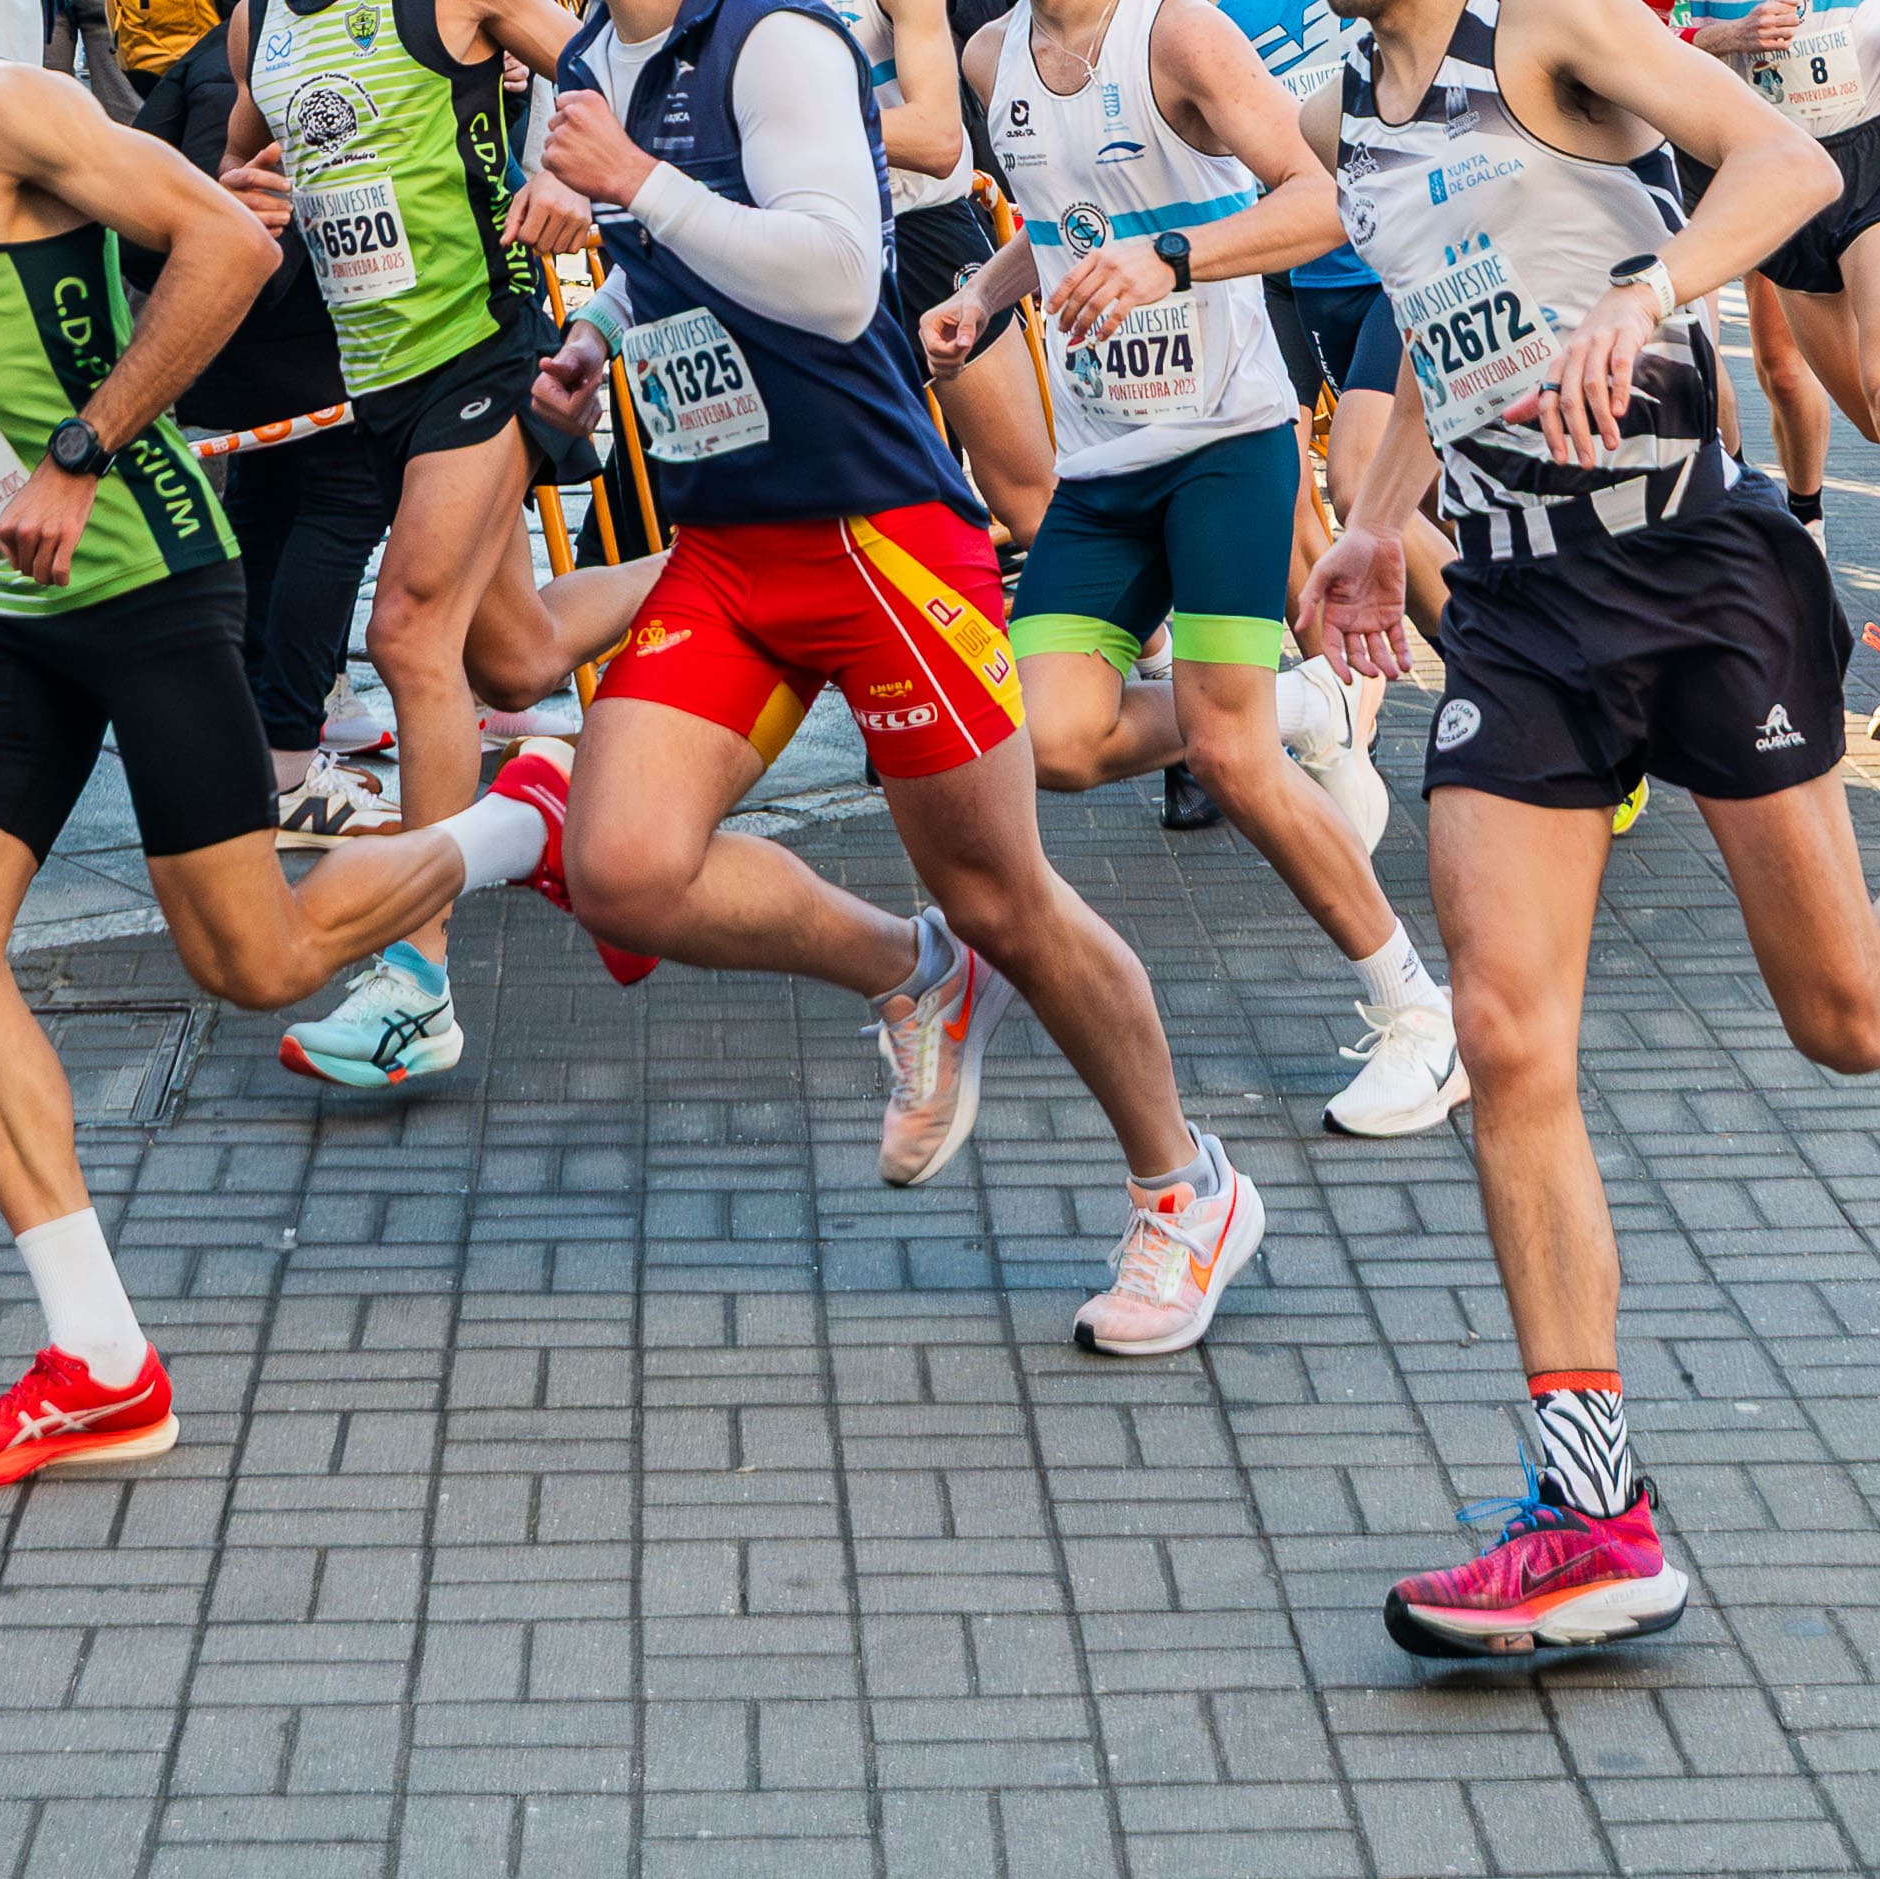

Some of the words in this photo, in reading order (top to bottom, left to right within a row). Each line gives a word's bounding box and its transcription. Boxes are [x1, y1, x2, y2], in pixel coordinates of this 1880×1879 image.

[1793, 30, 1849, 58] SILVESTRE
[1810, 56, 1829, 84] 8
[1446, 153, 1490, 177] XUNTA
[1448, 178, 1464, 196] DE
[1466, 158, 1524, 187] GALICIA
[327, 184, 390, 217] SILVESTRE
[322, 211, 398, 258] 6520
[331, 257, 381, 279] PONTEVEDRA
[381, 251, 406, 271] 2025
[1404, 289, 1430, 327] SAN
[1424, 254, 1508, 315] SILVESTRE
[1428, 290, 1536, 374] 2672
[665, 343, 743, 406] 1325
[1106, 333, 1193, 379] 4074
[1448, 355, 1521, 402] PONTEVEDRA
[1516, 337, 1551, 368] 2025
[1108, 381, 1171, 401] PONTEVEDRA
[1174, 378, 1197, 395] 2025
[677, 401, 735, 431] PONTEVEDRA
[733, 394, 758, 417] 2025
[869, 679, 914, 696] AMURA
